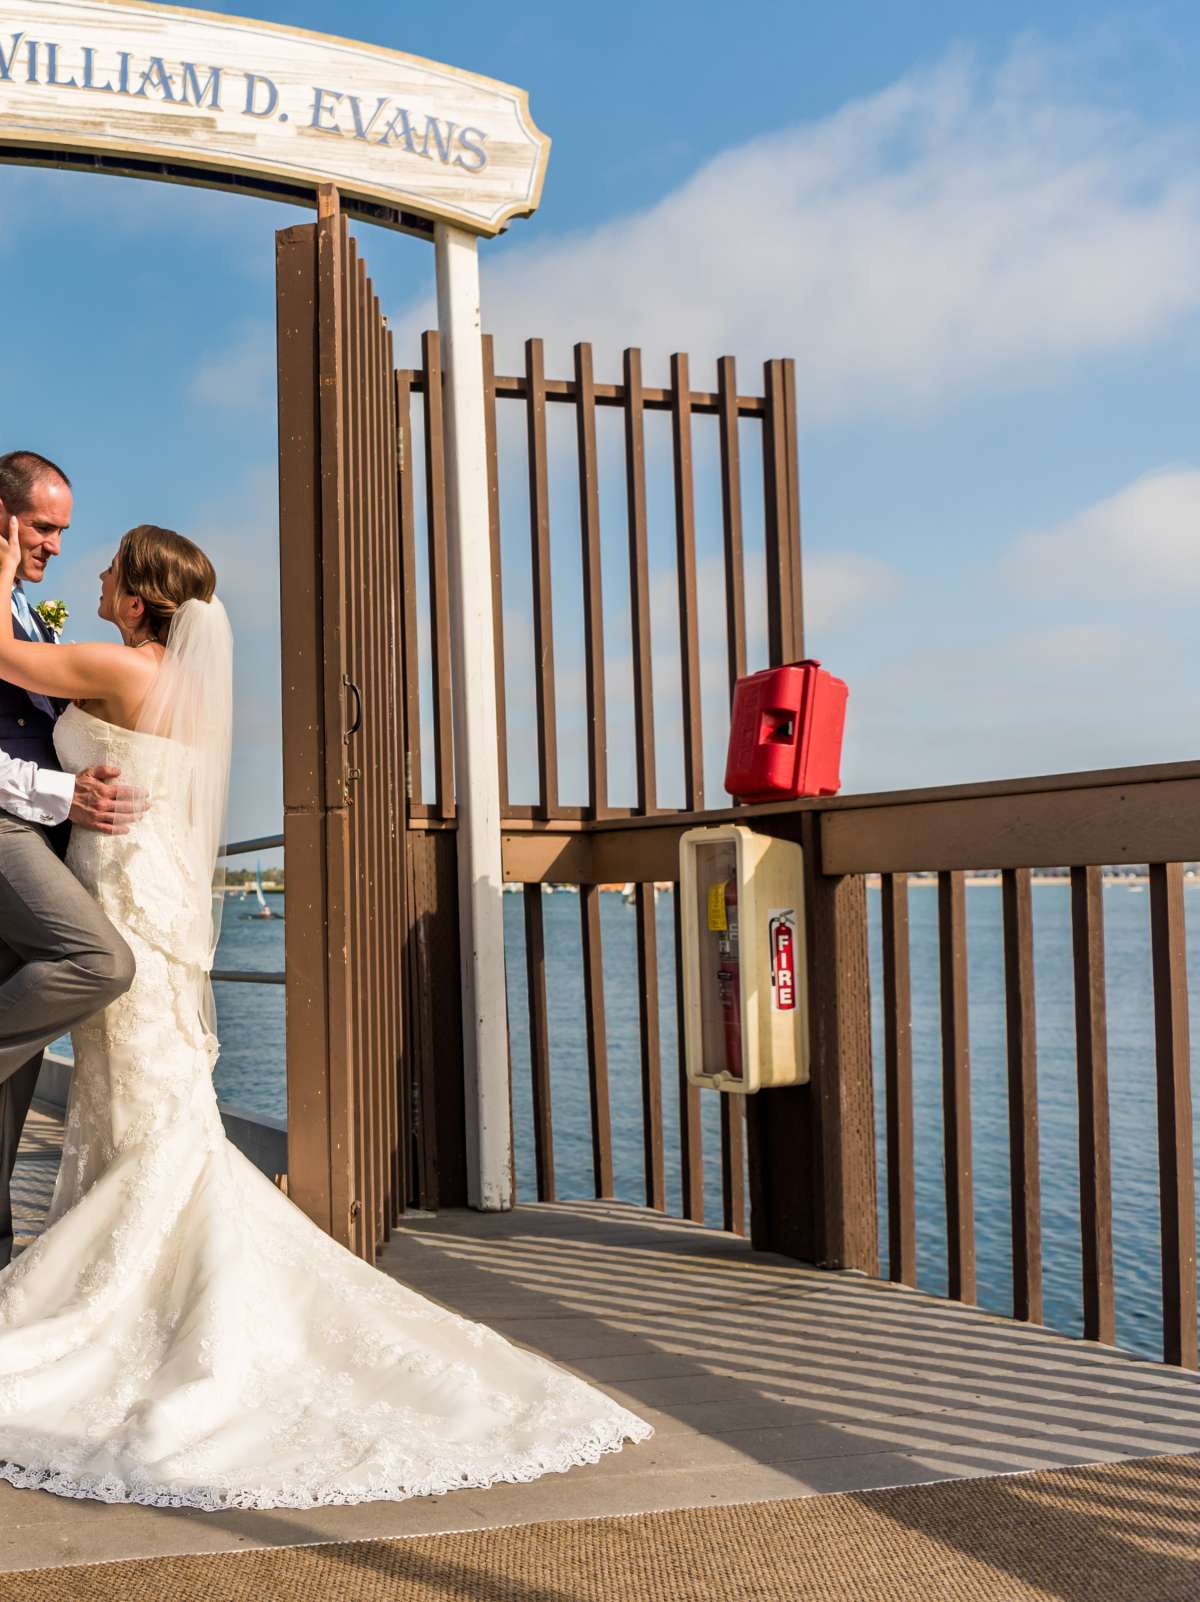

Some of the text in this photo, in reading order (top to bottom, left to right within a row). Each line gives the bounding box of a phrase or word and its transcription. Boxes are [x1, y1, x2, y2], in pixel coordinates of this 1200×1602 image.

[242, 72, 289, 123] D.
[309, 86, 489, 173] EVANS
[778, 935, 792, 1004] FIRE
